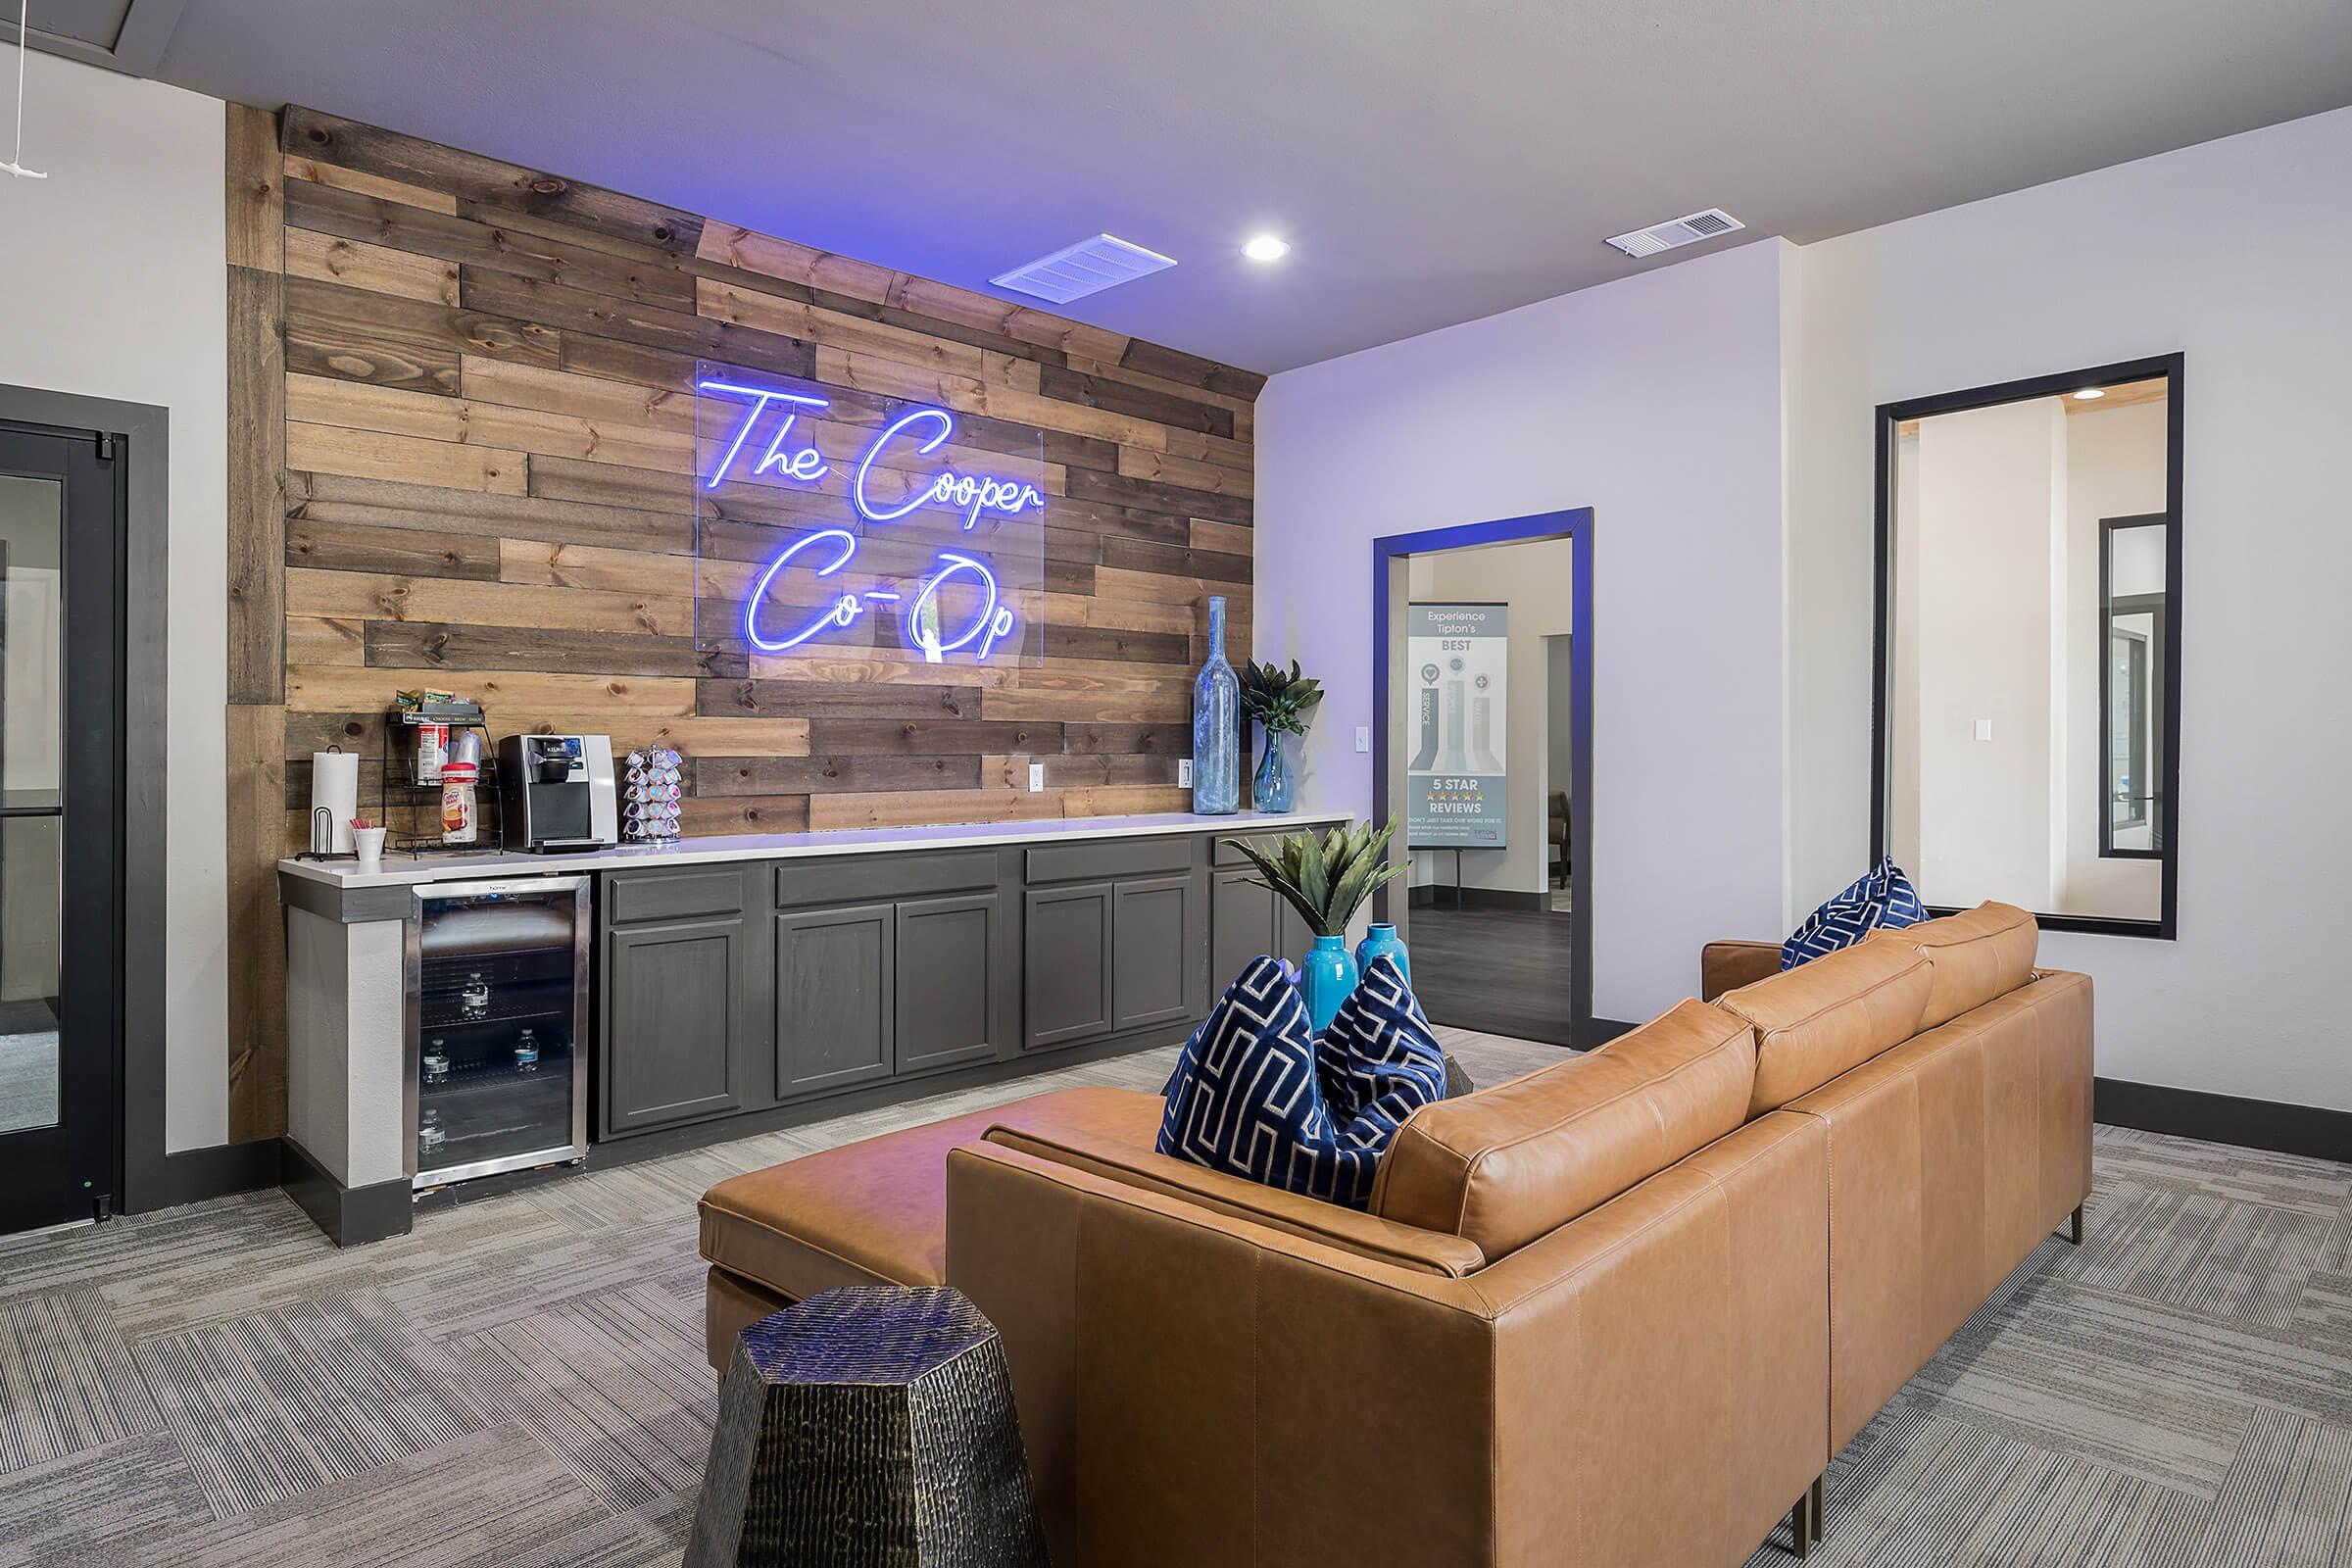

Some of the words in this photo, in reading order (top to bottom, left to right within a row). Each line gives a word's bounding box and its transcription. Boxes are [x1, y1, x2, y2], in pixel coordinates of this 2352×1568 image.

[700, 381, 829, 488] The
[854, 410, 1044, 530] Cooper
[745, 530, 1013, 660] Co-Op
[1428, 611, 1486, 622] Experience
[1437, 623, 1476, 634] Tipton's
[1442, 640, 1471, 651] BEST
[1422, 692, 1431, 726] SERVICE
[1433, 779, 1442, 790] 5
[1445, 779, 1478, 790] STAR
[1430, 803, 1482, 813] REVIEWS
